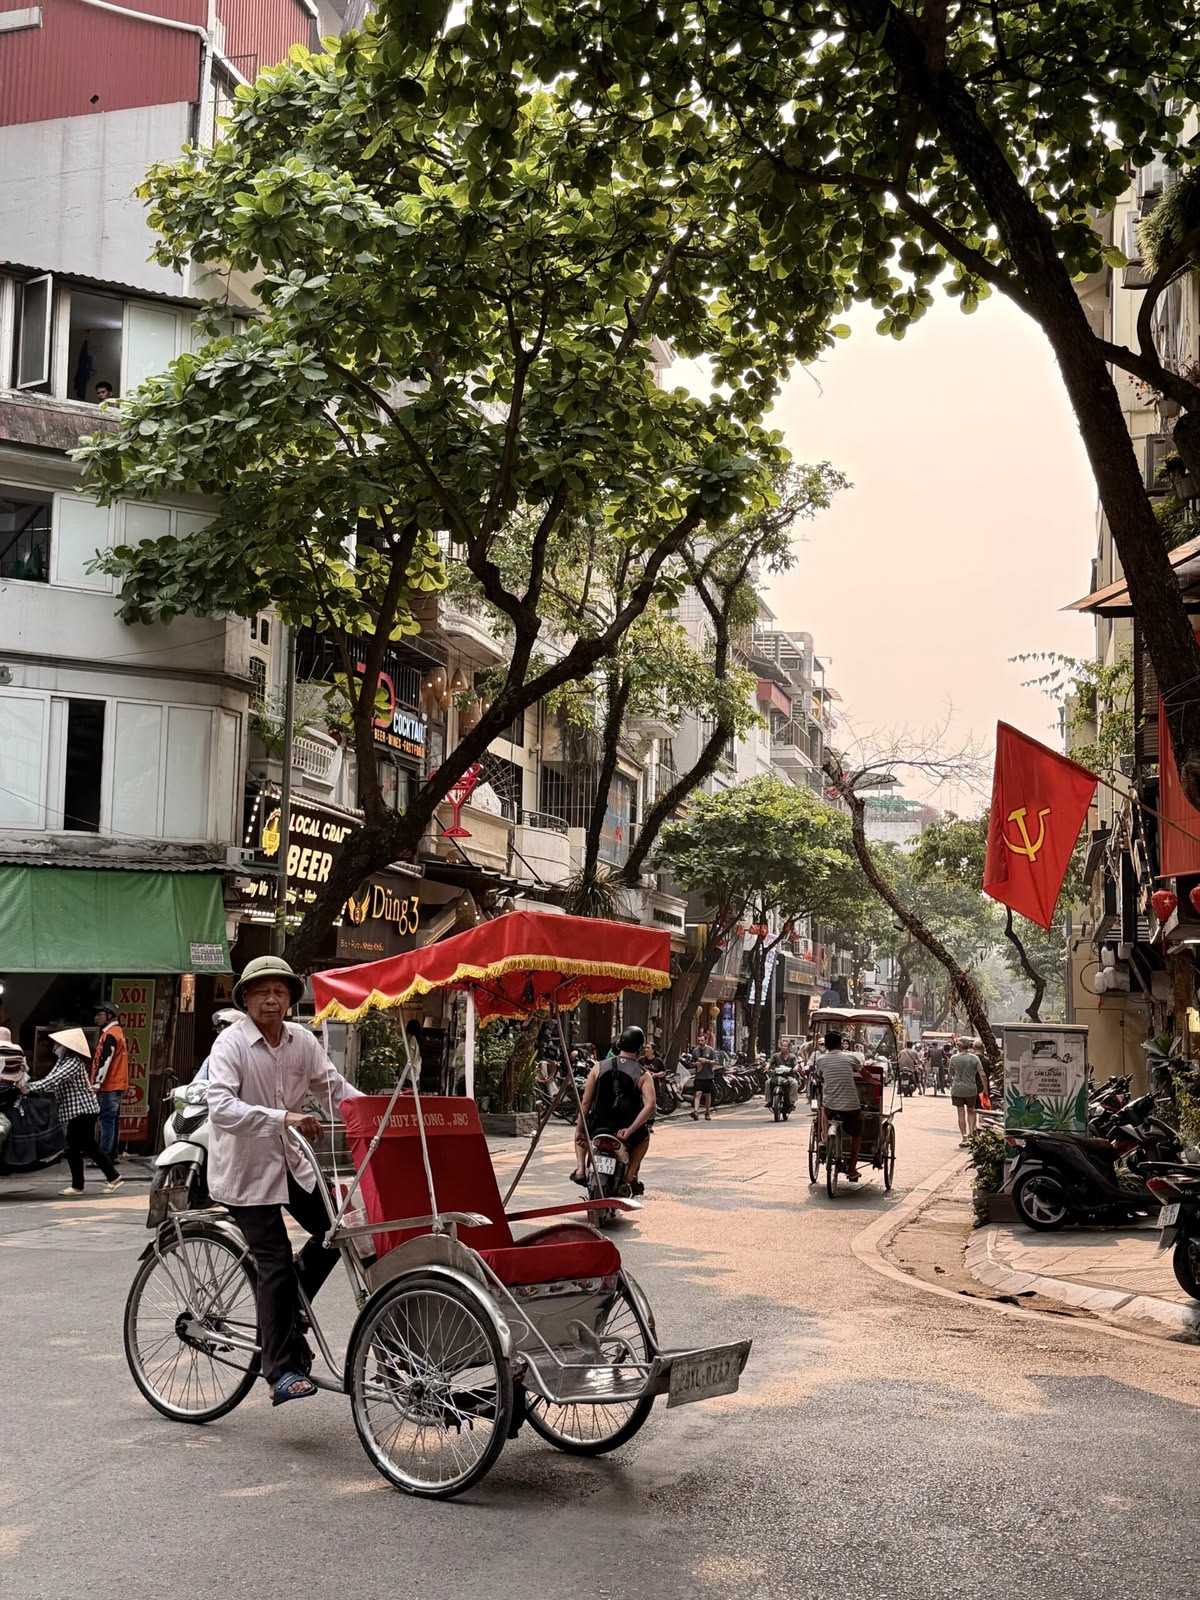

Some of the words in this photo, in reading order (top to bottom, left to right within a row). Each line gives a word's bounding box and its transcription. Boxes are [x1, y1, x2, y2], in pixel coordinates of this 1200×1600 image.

[393, 712, 424, 744] COCKTAIL
[288, 813, 321, 837] LOCAL
[286, 844, 333, 883] BEER
[119, 983, 147, 1004] XÔI
[118, 1008, 146, 1029] CHÈ
[390, 1113, 410, 1128] HUY
[410, 1112, 445, 1128] PONG
